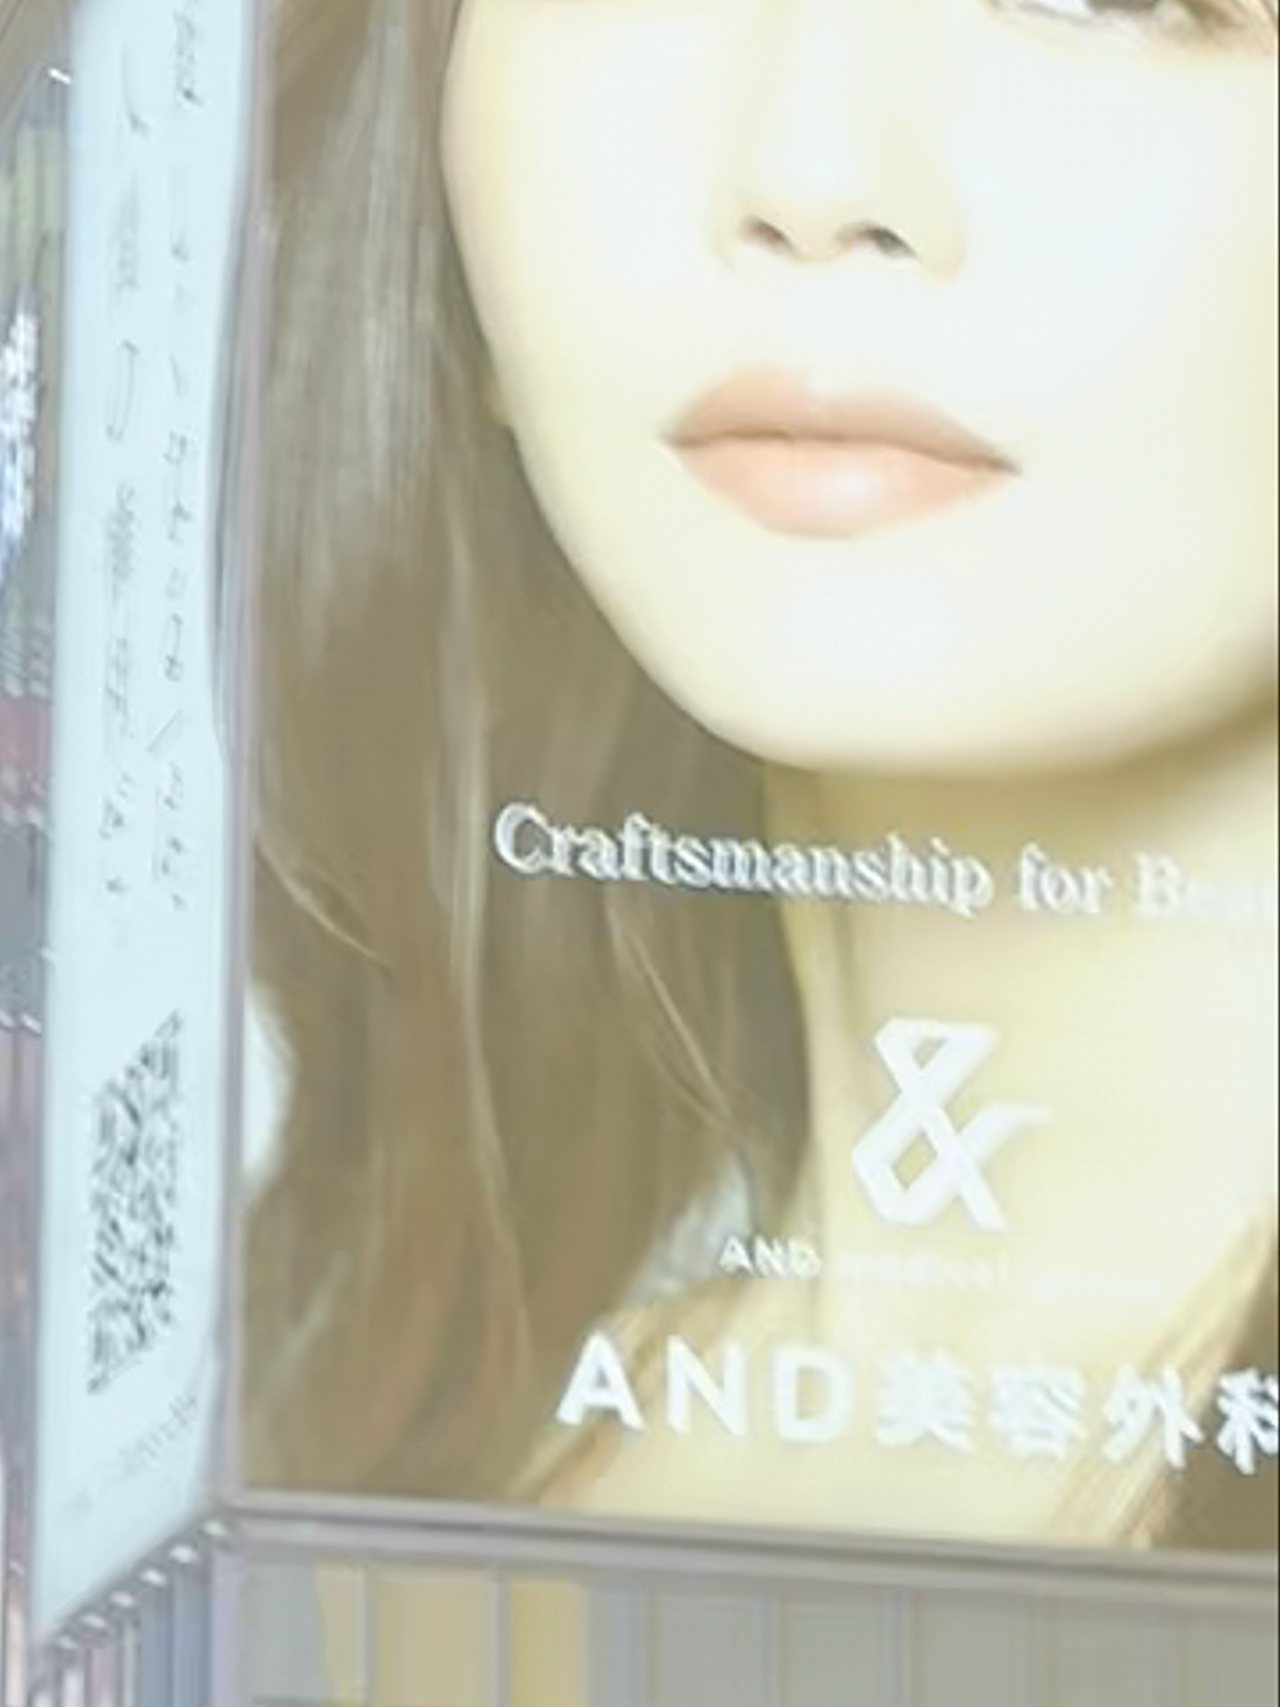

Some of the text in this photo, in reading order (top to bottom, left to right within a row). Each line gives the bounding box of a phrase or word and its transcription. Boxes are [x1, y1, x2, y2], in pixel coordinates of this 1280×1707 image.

[493, 801, 993, 917] Craftsmanship
[1013, 843, 1113, 917] for
[717, 1234, 822, 1278] AND
